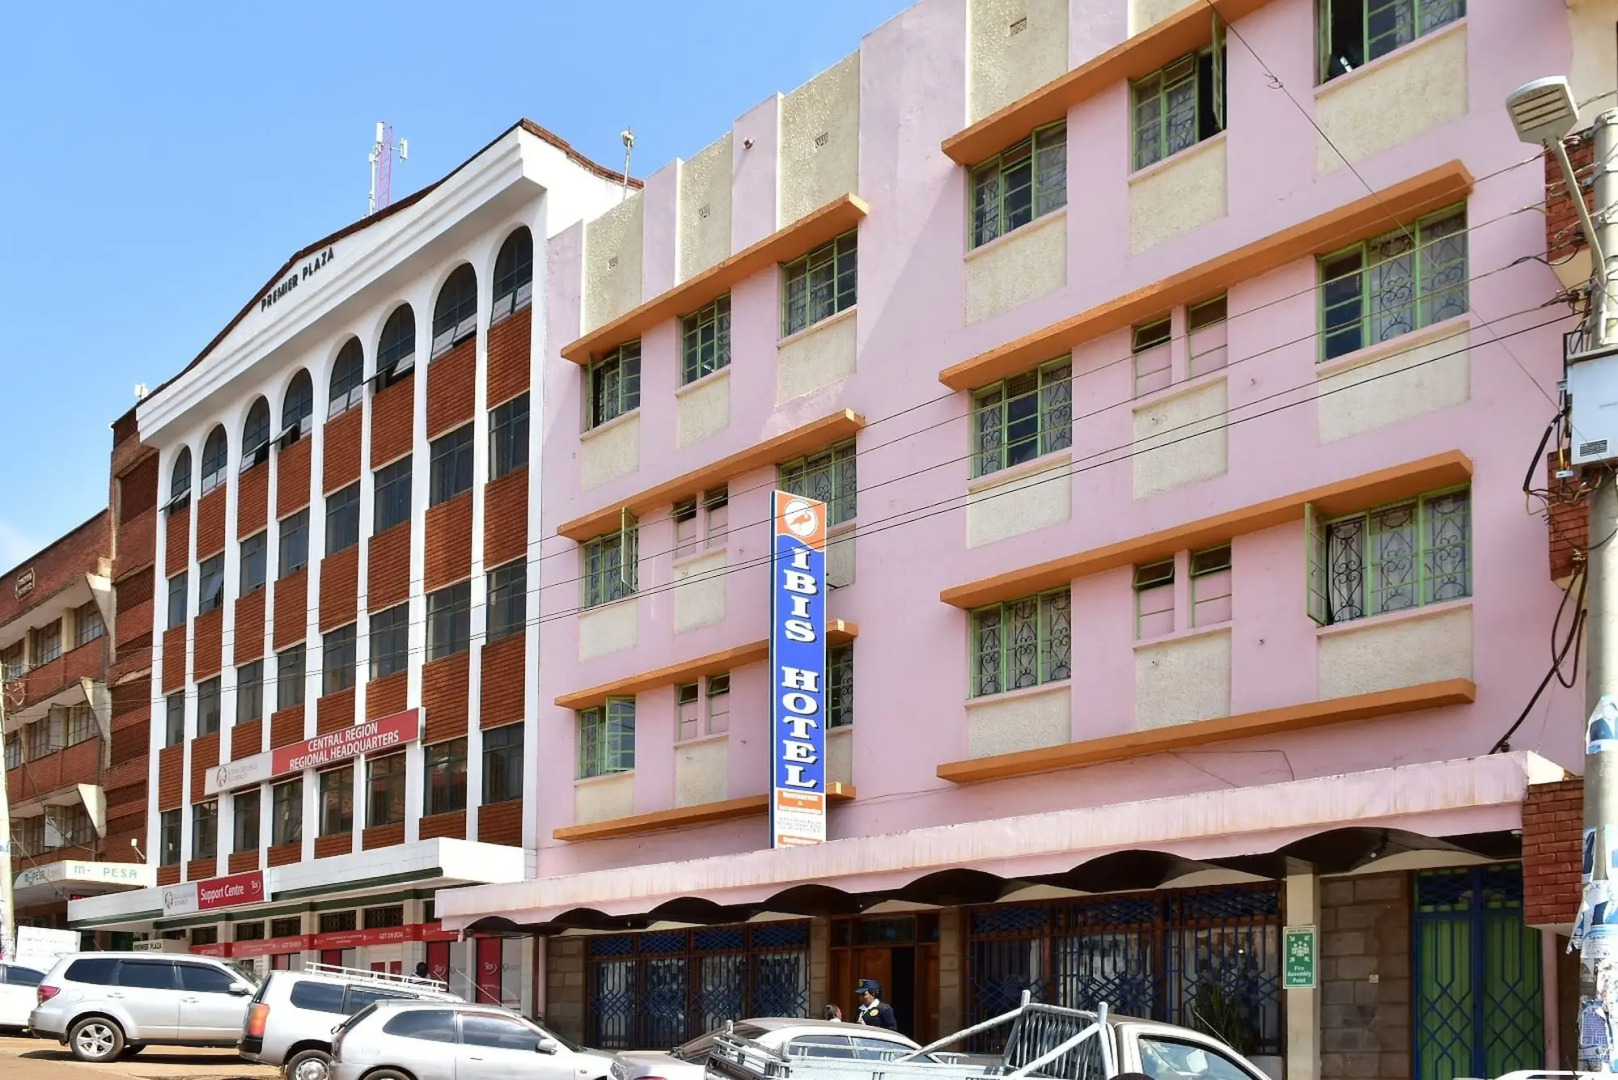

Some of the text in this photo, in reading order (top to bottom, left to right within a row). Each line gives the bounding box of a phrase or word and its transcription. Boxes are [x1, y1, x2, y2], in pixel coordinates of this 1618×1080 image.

[261, 247, 334, 312] PREMIER PLAZA
[783, 547, 818, 643] IBIS
[308, 722, 378, 752] CENTRAL REGION
[781, 666, 820, 789] HOTEL
[289, 730, 399, 771] REGIONAL HEADQUARTERS
[103, 867, 137, 879] PESA
[200, 887, 224, 904] Support
[224, 884, 245, 897] Centre
